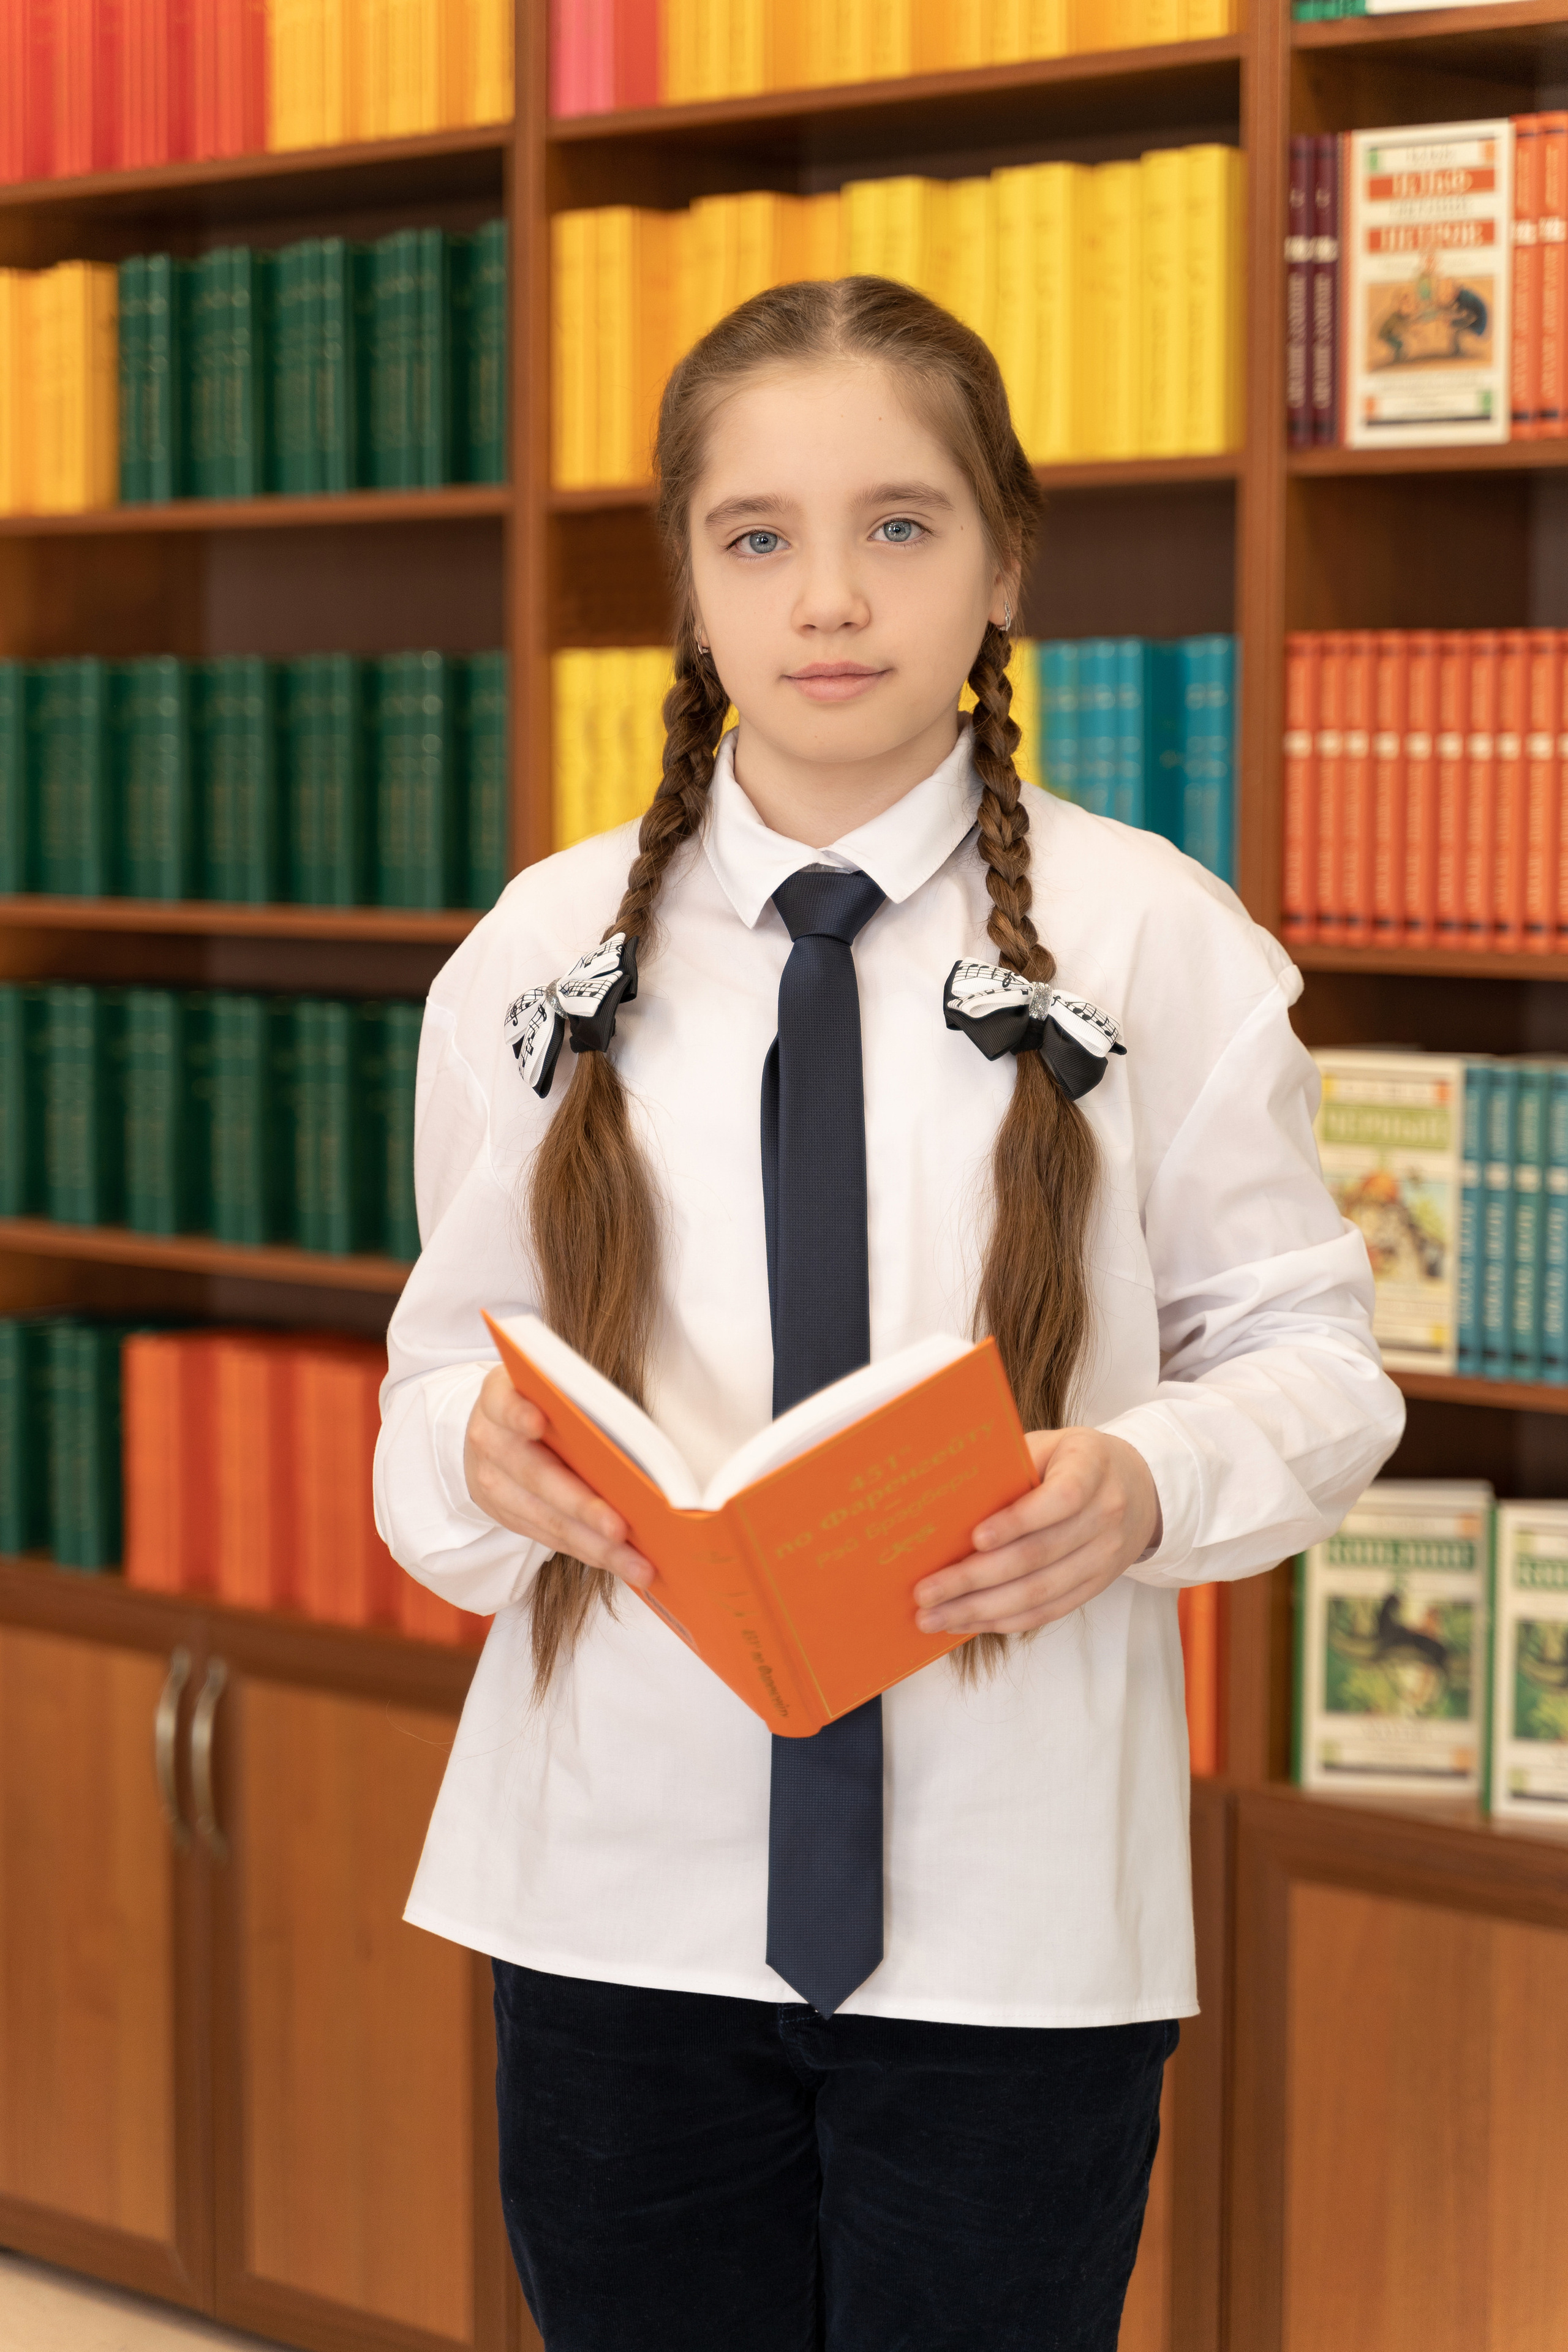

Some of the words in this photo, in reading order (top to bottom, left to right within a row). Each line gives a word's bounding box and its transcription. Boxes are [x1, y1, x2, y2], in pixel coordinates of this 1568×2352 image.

[774, 1531, 813, 1559] по
[820, 1417, 995, 1529] Фаренгейту
[815, 1536, 859, 1569] Рэй
[864, 1464, 979, 1540] Брэдбери
